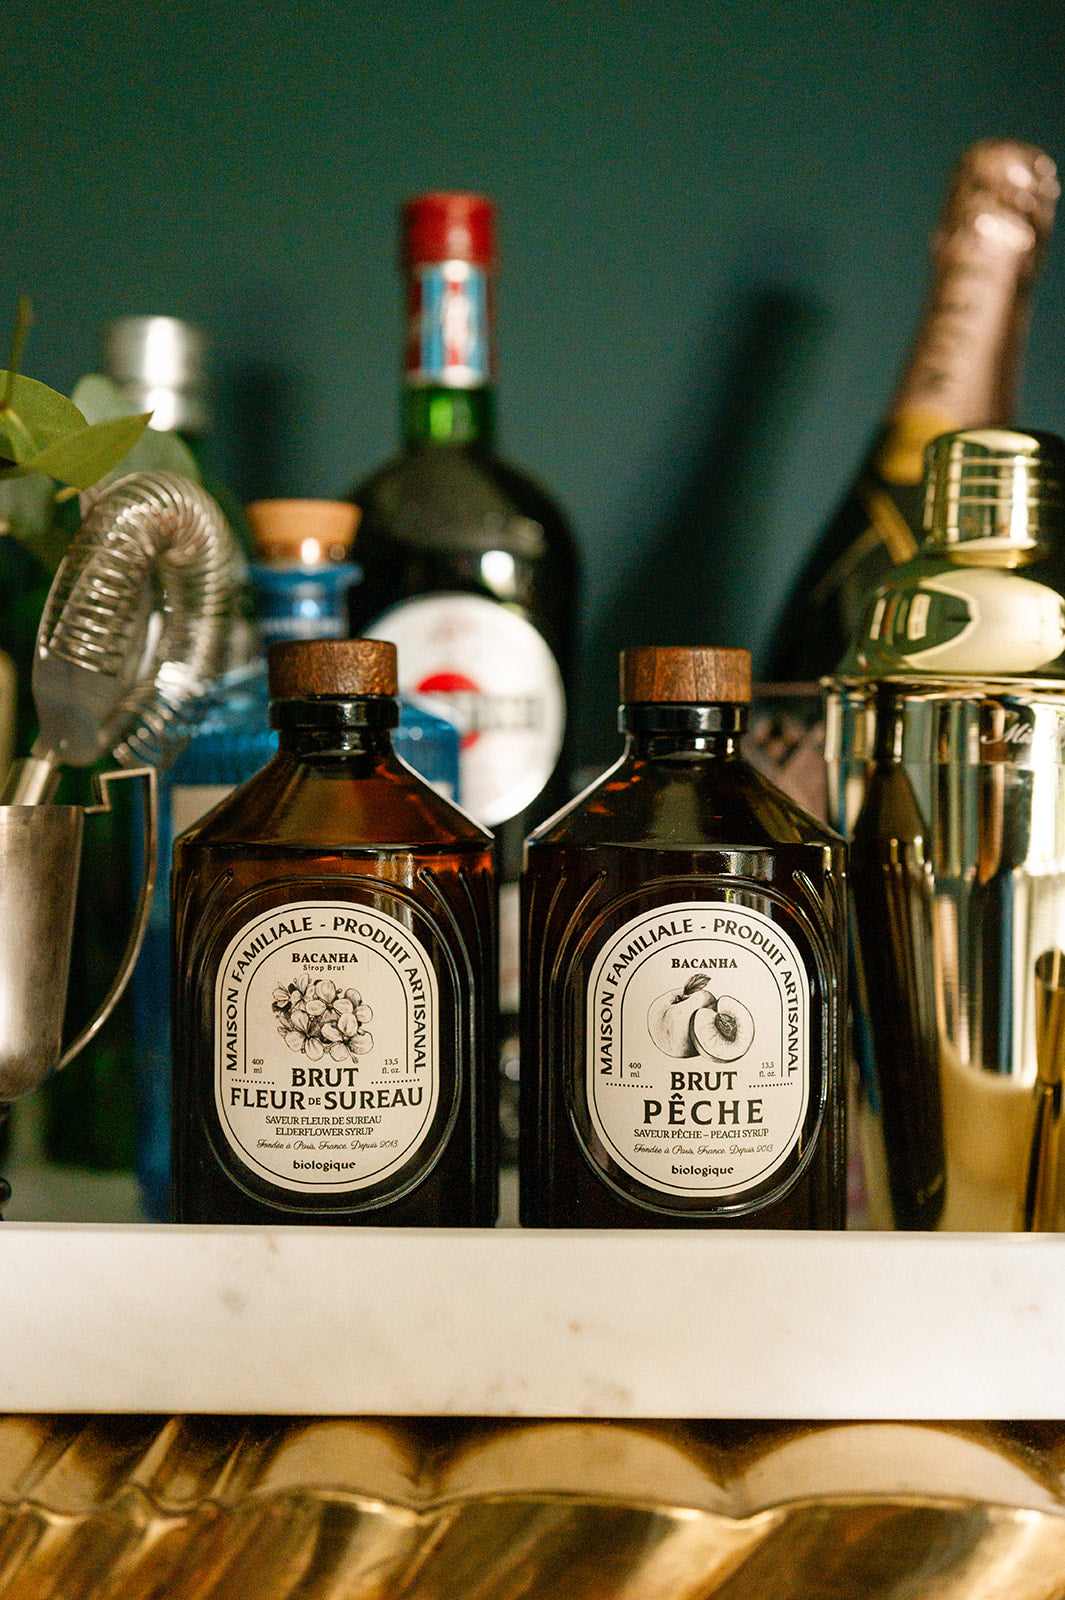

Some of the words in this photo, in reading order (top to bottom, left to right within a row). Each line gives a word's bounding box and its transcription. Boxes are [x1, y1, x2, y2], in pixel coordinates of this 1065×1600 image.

[291, 953, 359, 963] BACANHA
[671, 958, 737, 968] BACANHA
[303, 964, 325, 972] Sirop
[225, 987, 239, 1071] MAISON
[232, 916, 312, 983] FAMILIALE
[333, 917, 411, 964] PRODUIT
[405, 968, 426, 1073] ARTISANAL
[600, 991, 614, 1075] MAISON
[607, 919, 693, 986] FAMILIALE
[713, 918, 786, 967] PRODUIT
[781, 970, 798, 1077] ARTISANAL
[292, 1067, 359, 1087] BRUT
[670, 1071, 737, 1091] BRUT
[230, 1087, 305, 1111] FLEUR
[308, 1097, 321, 1106] DE
[324, 1087, 423, 1110] SUREAU
[643, 1093, 763, 1125] PÊCHE
[265, 1115, 300, 1125] SAVEUR
[301, 1116, 331, 1125] FLEUR
[332, 1116, 344, 1125] DE
[345, 1115, 381, 1124] SUREAU
[275, 1127, 344, 1137] ELDERFLOWER
[345, 1127, 373, 1137] SYRUP
[634, 1129, 669, 1138] SAVEUR
[671, 1128, 702, 1139] PÊCHE
[710, 1129, 741, 1139] PEACH
[742, 1129, 769, 1138] SYRUP
[293, 1159, 355, 1172] biologique
[671, 1165, 734, 1177] biologique
